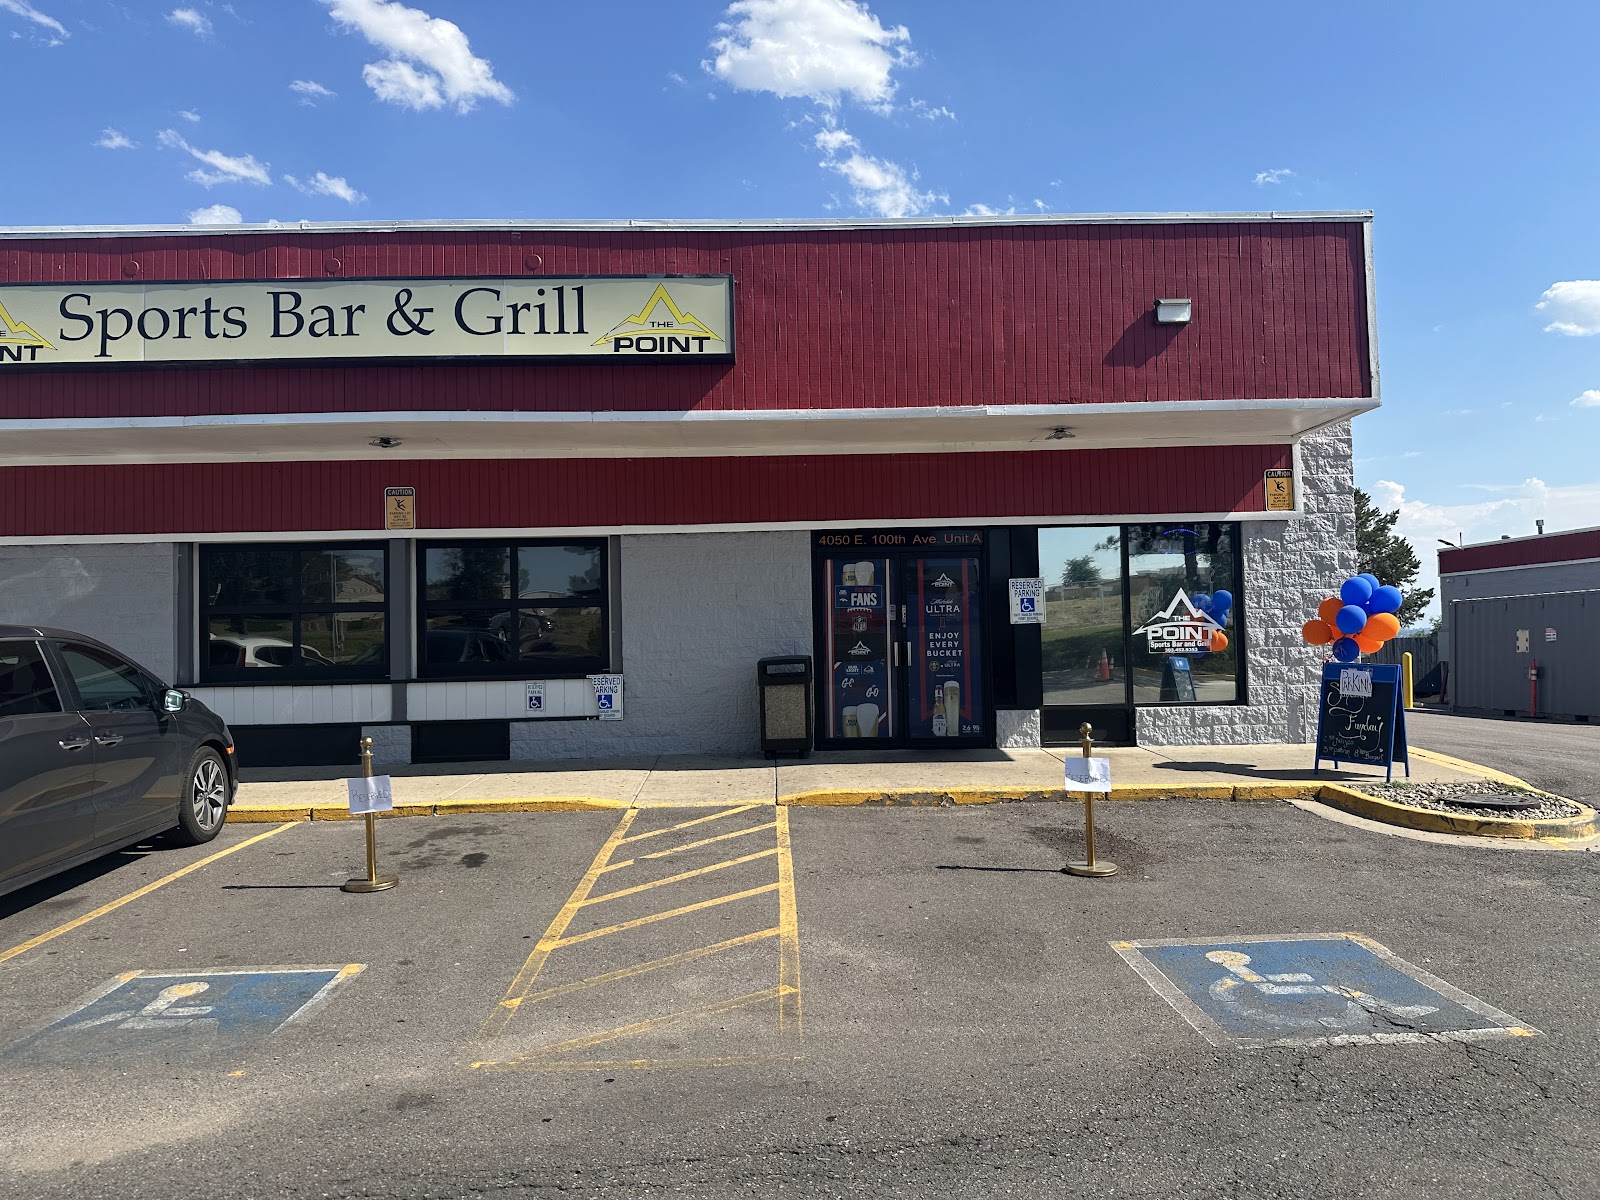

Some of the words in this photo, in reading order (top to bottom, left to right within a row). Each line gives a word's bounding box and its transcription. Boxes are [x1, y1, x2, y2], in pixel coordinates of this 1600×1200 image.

[59, 293, 248, 358] Sports
[266, 291, 365, 338] Bar
[386, 288, 435, 336] &
[454, 285, 589, 335] Grill
[613, 337, 711, 353] POINT
[819, 535, 850, 545] 4050
[854, 535, 867, 545] E.
[871, 534, 906, 545] 100th
[912, 534, 940, 545] Ave.
[943, 533, 970, 544] Unit
[971, 533, 982, 543] A
[1011, 581, 1042, 589] RESERVED
[1014, 589, 1040, 597] PARKING
[850, 592, 877, 606] FANS
[925, 605, 961, 613] ULTRA
[1147, 627, 1212, 640] POINT
[1150, 641, 1170, 649] Sports
[592, 677, 621, 686] ESERVED
[593, 685, 618, 694] ARKING
